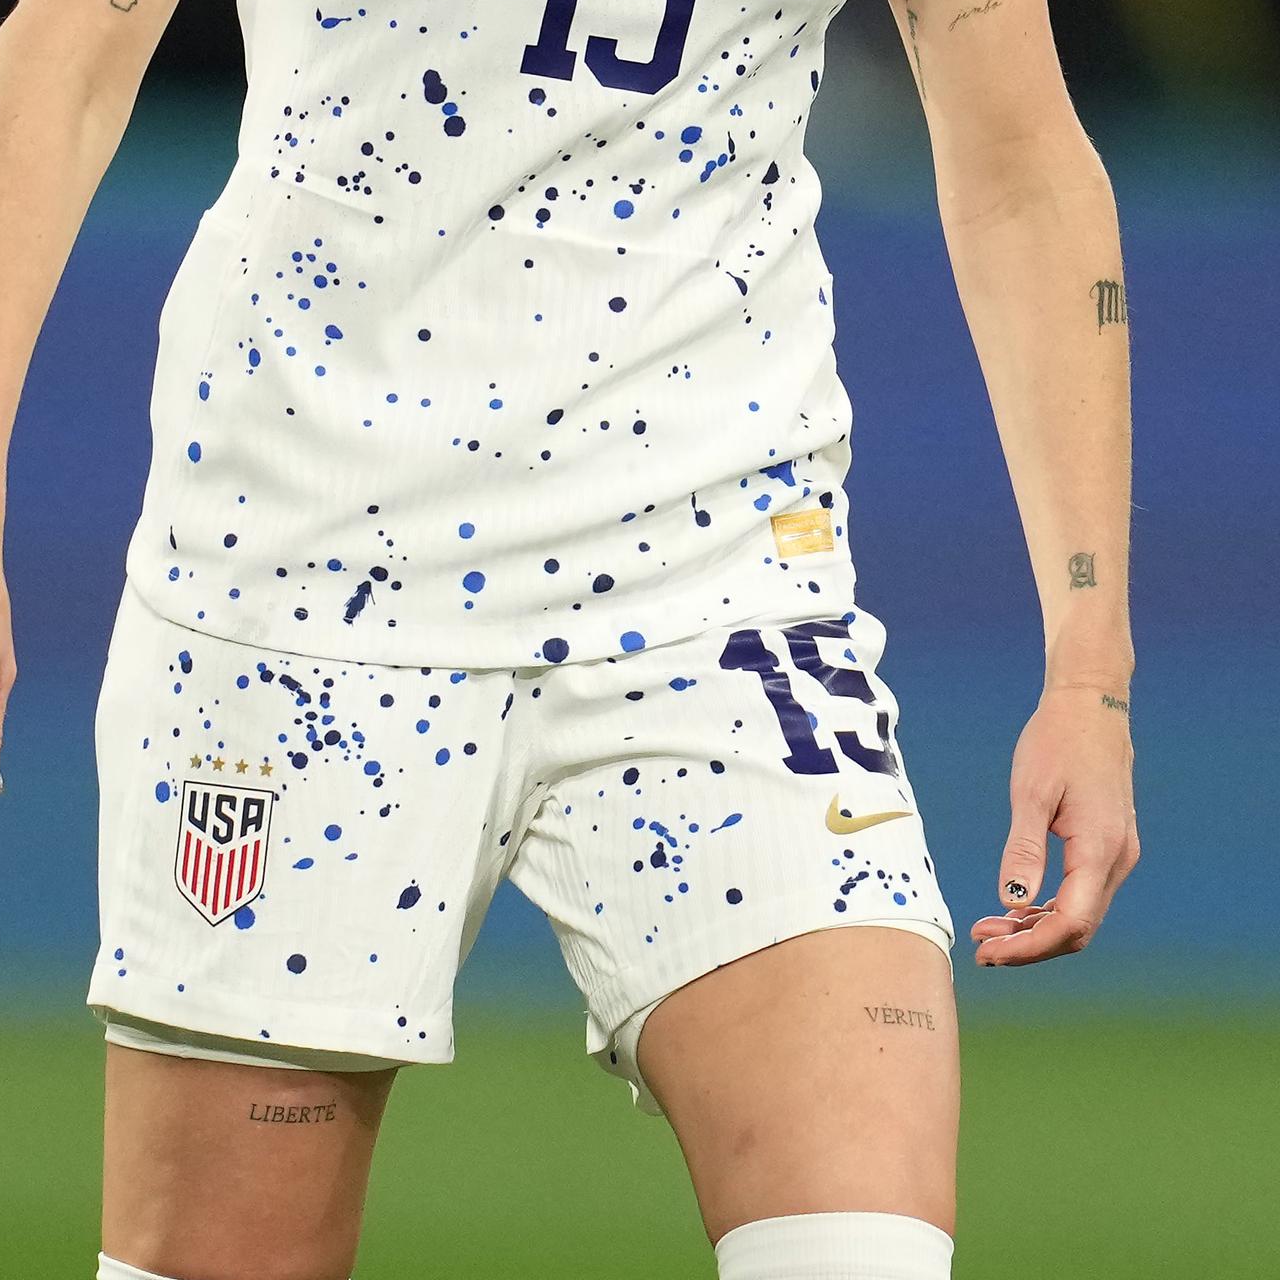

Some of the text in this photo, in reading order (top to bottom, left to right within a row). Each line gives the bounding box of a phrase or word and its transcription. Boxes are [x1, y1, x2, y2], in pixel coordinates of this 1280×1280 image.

[719, 619, 900, 778] 15
[188, 790, 265, 845] USA
[864, 1002, 936, 1031] VÉRITÉ
[249, 1099, 337, 1124] LIBERTÉ
